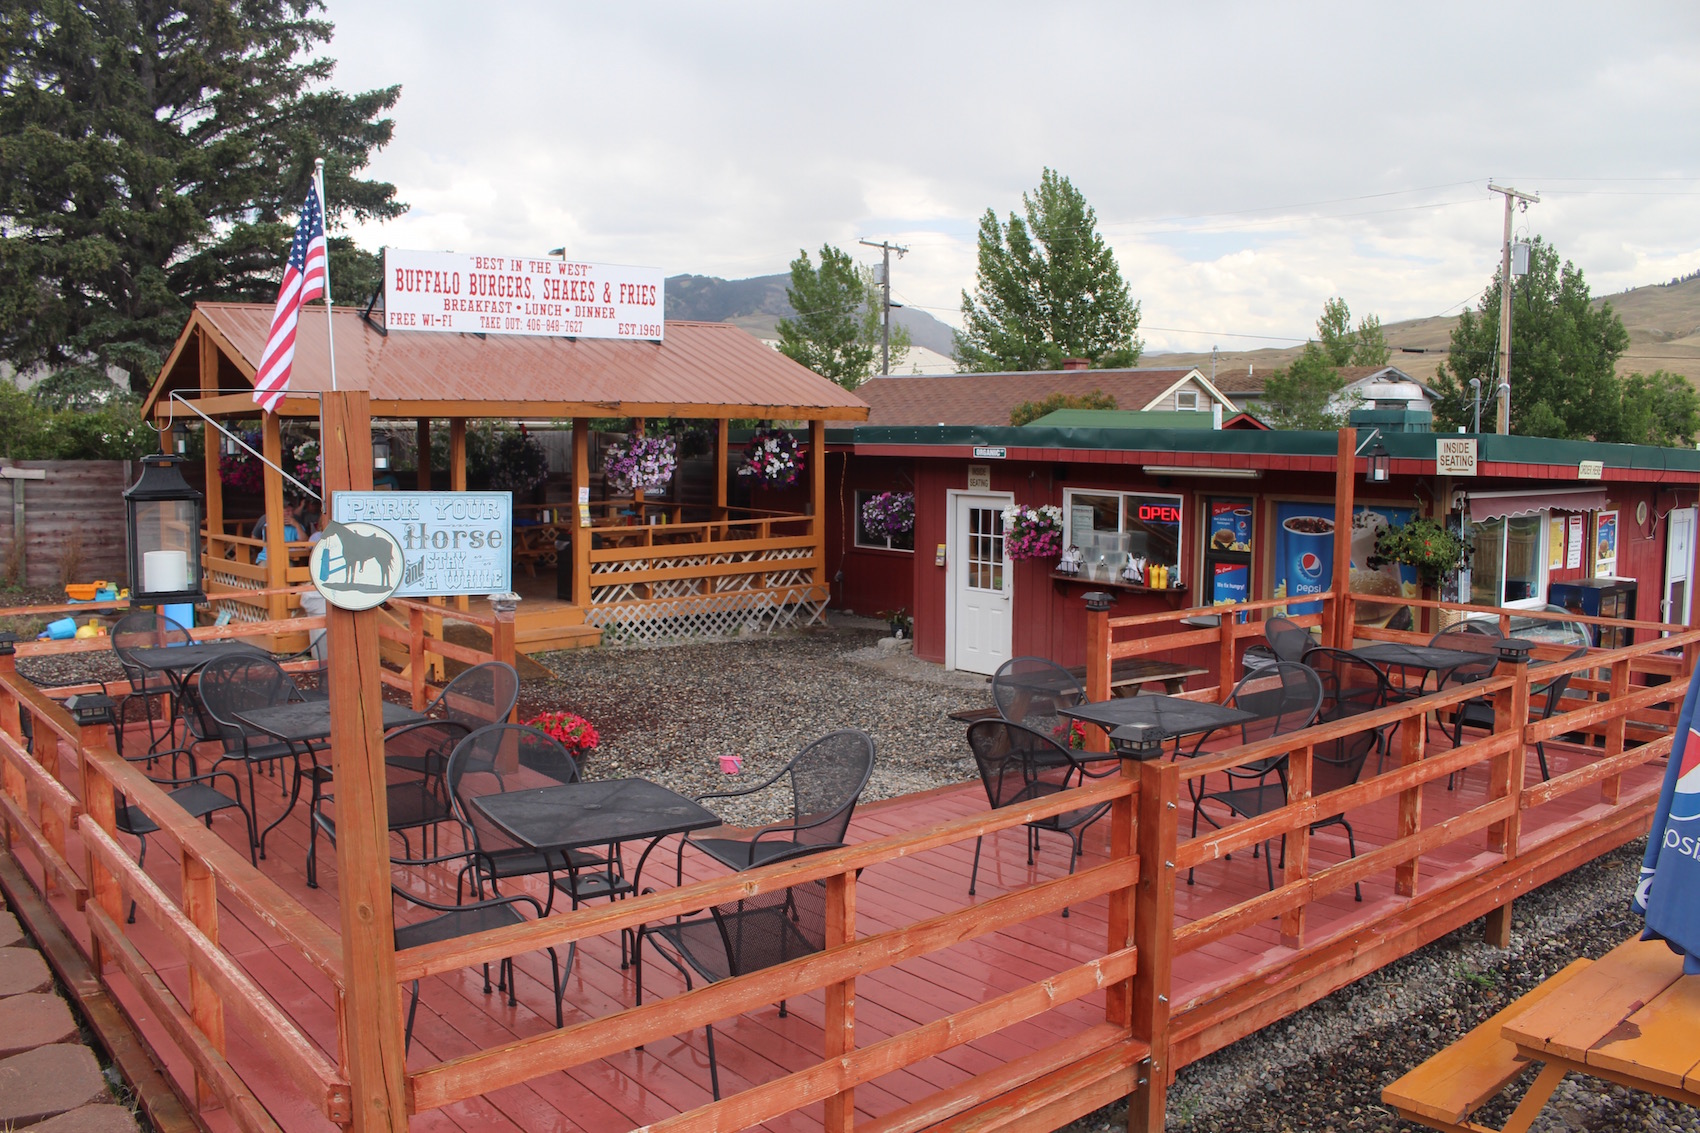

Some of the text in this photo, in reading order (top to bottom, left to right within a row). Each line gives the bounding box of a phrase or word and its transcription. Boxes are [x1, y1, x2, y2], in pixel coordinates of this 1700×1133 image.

[511, 259, 522, 272] IN
[529, 261, 551, 274] THE
[395, 268, 656, 306] BUFFALO BURGERS, SHAKES & FRIES
[444, 298, 615, 319] BREAKFAST LUNCH DINNER
[390, 312, 416, 326] FREE
[422, 314, 452, 327] WI-FI
[480, 316, 501, 329] TAKE
[505, 317, 523, 330] OUT:
[526, 318, 583, 333] 406-848-7627
[1443, 442, 1469, 454] INSIDE
[1440, 455, 1474, 467] SEATING
[969, 478, 988, 487] SEATING
[347, 499, 500, 520] PARK YOUR
[1139, 505, 1180, 521] OPEN
[402, 522, 502, 550] Horse
[405, 551, 467, 588] and STAY
[425, 569, 503, 590] A WHILE
[1296, 584, 1322, 594] pepsi
[1662, 826, 1700, 860] psi
